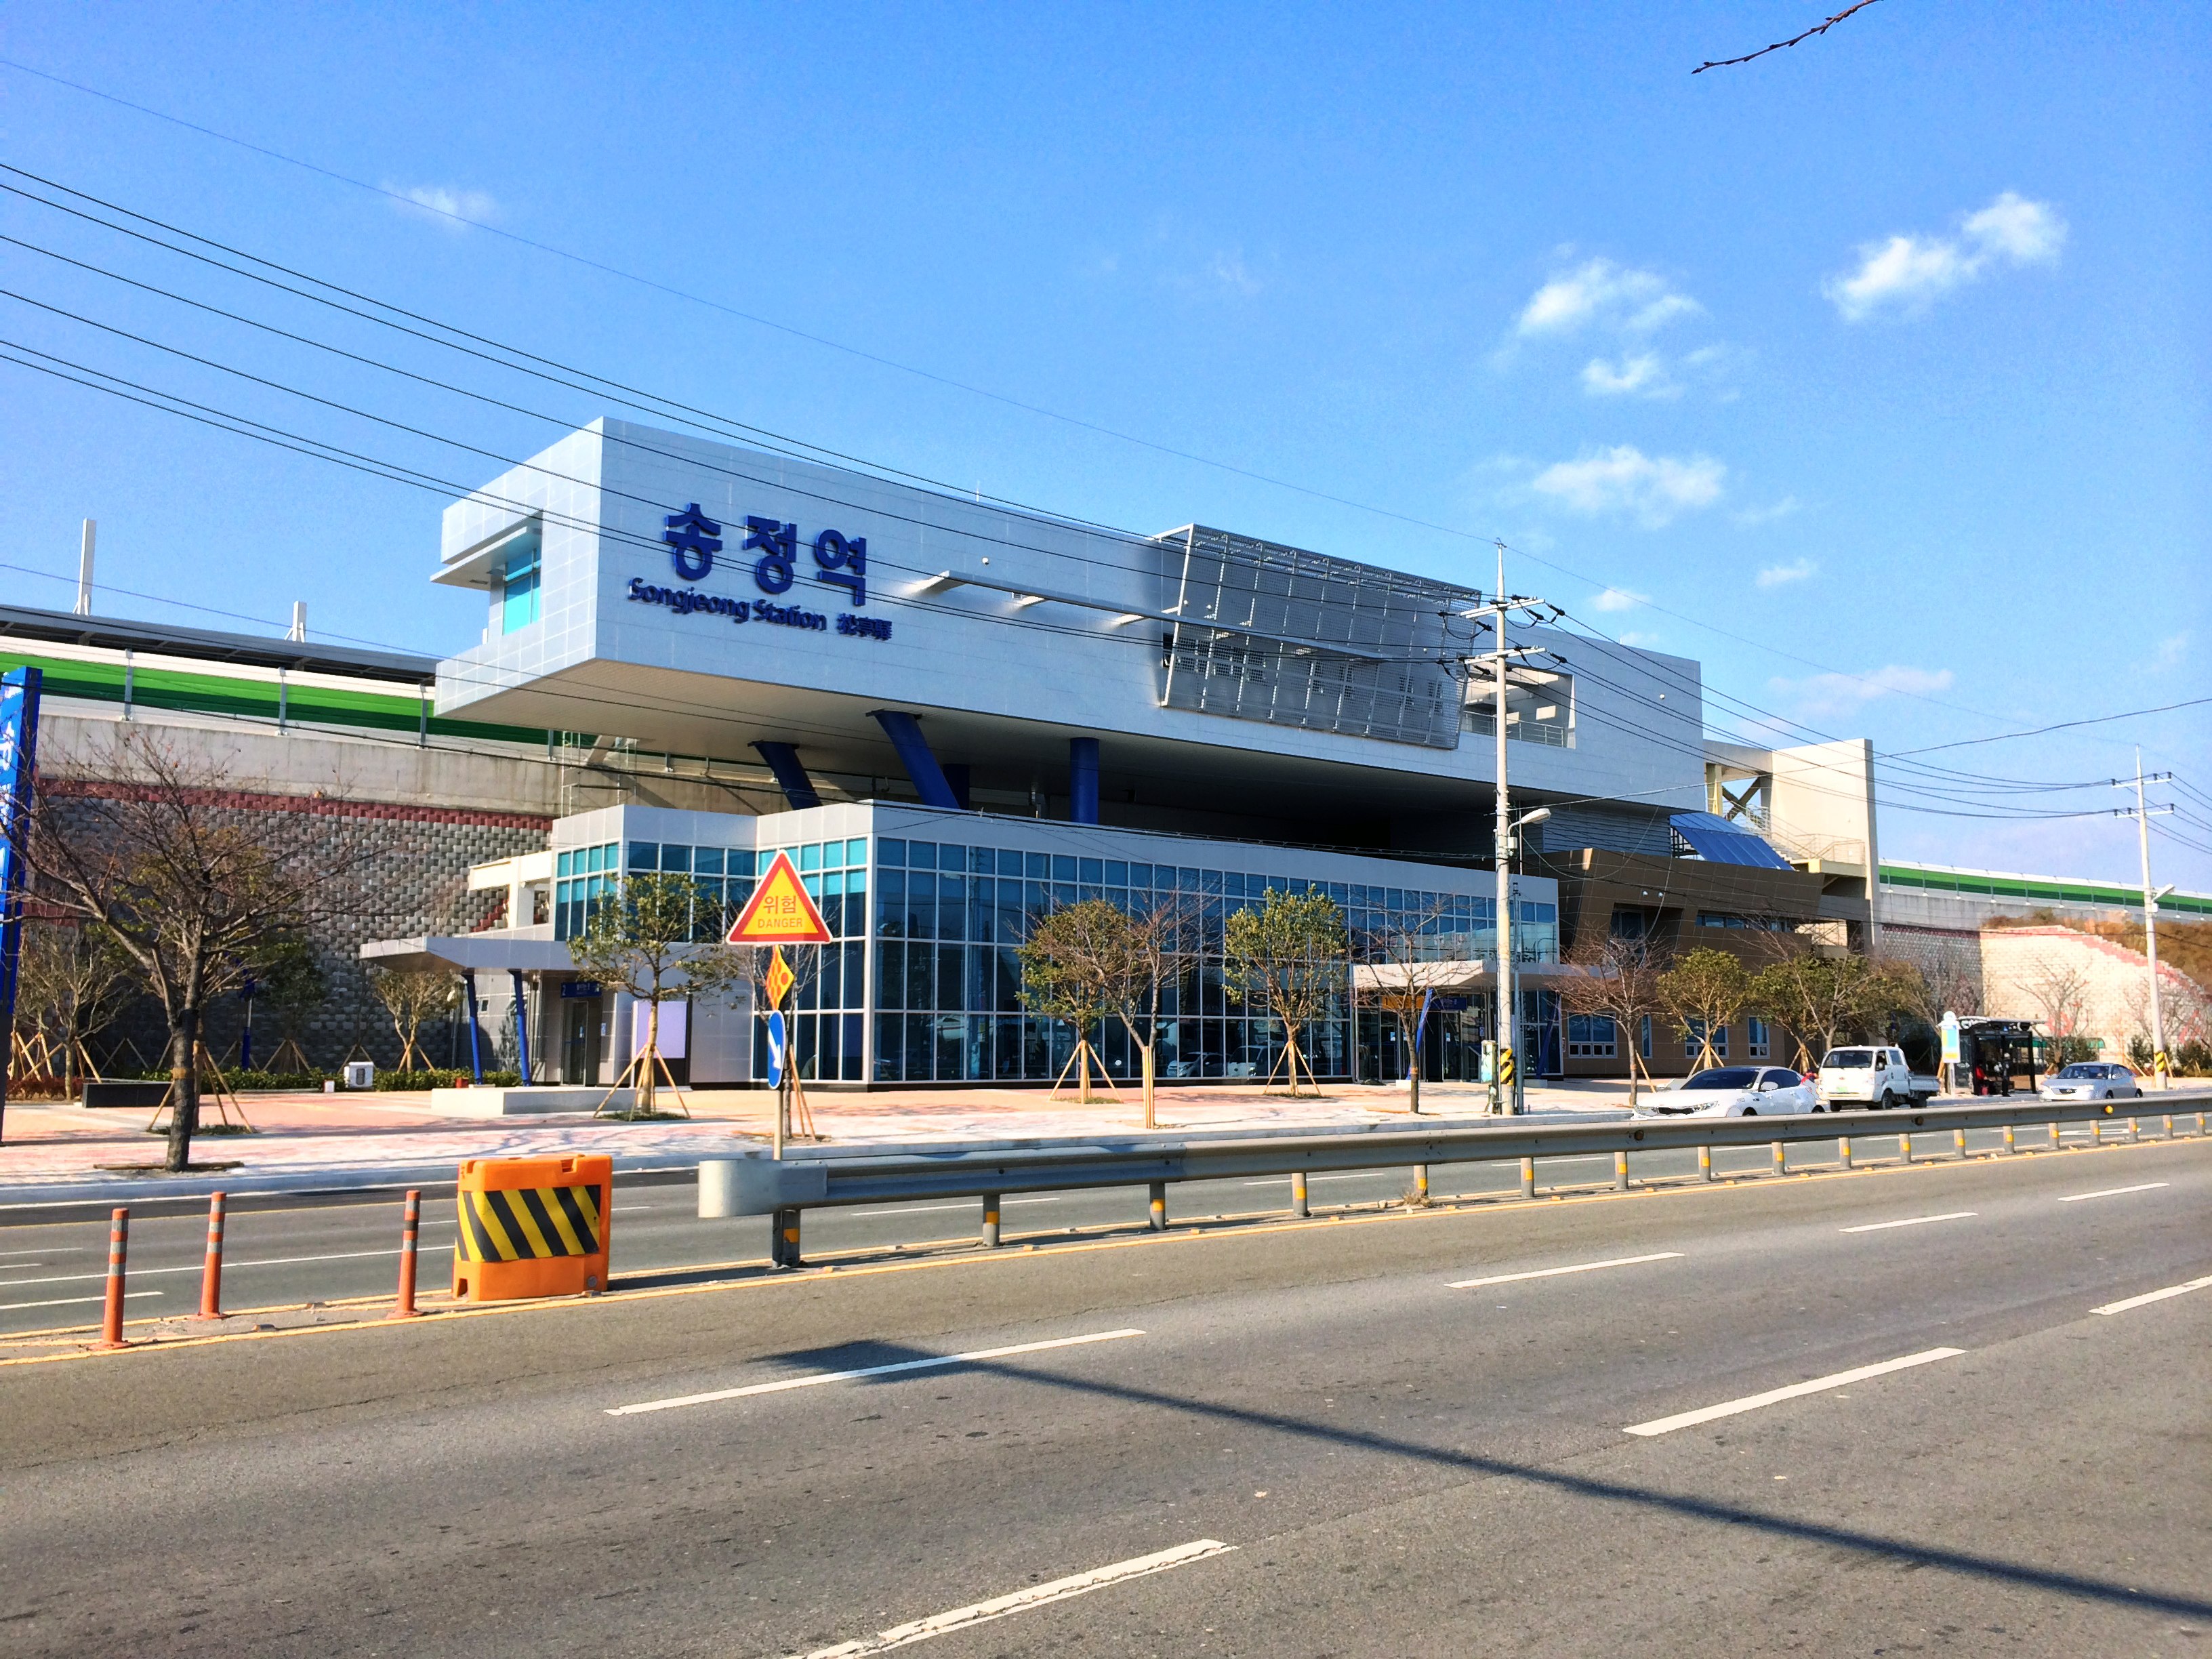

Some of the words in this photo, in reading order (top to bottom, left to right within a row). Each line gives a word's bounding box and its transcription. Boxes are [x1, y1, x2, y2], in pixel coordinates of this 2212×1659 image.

[663, 503, 867, 606] 송정역
[629, 578, 750, 623] Songjeong
[753, 599, 827, 631] Station
[763, 896, 796, 914] 위험
[758, 918, 802, 928] DANGER
